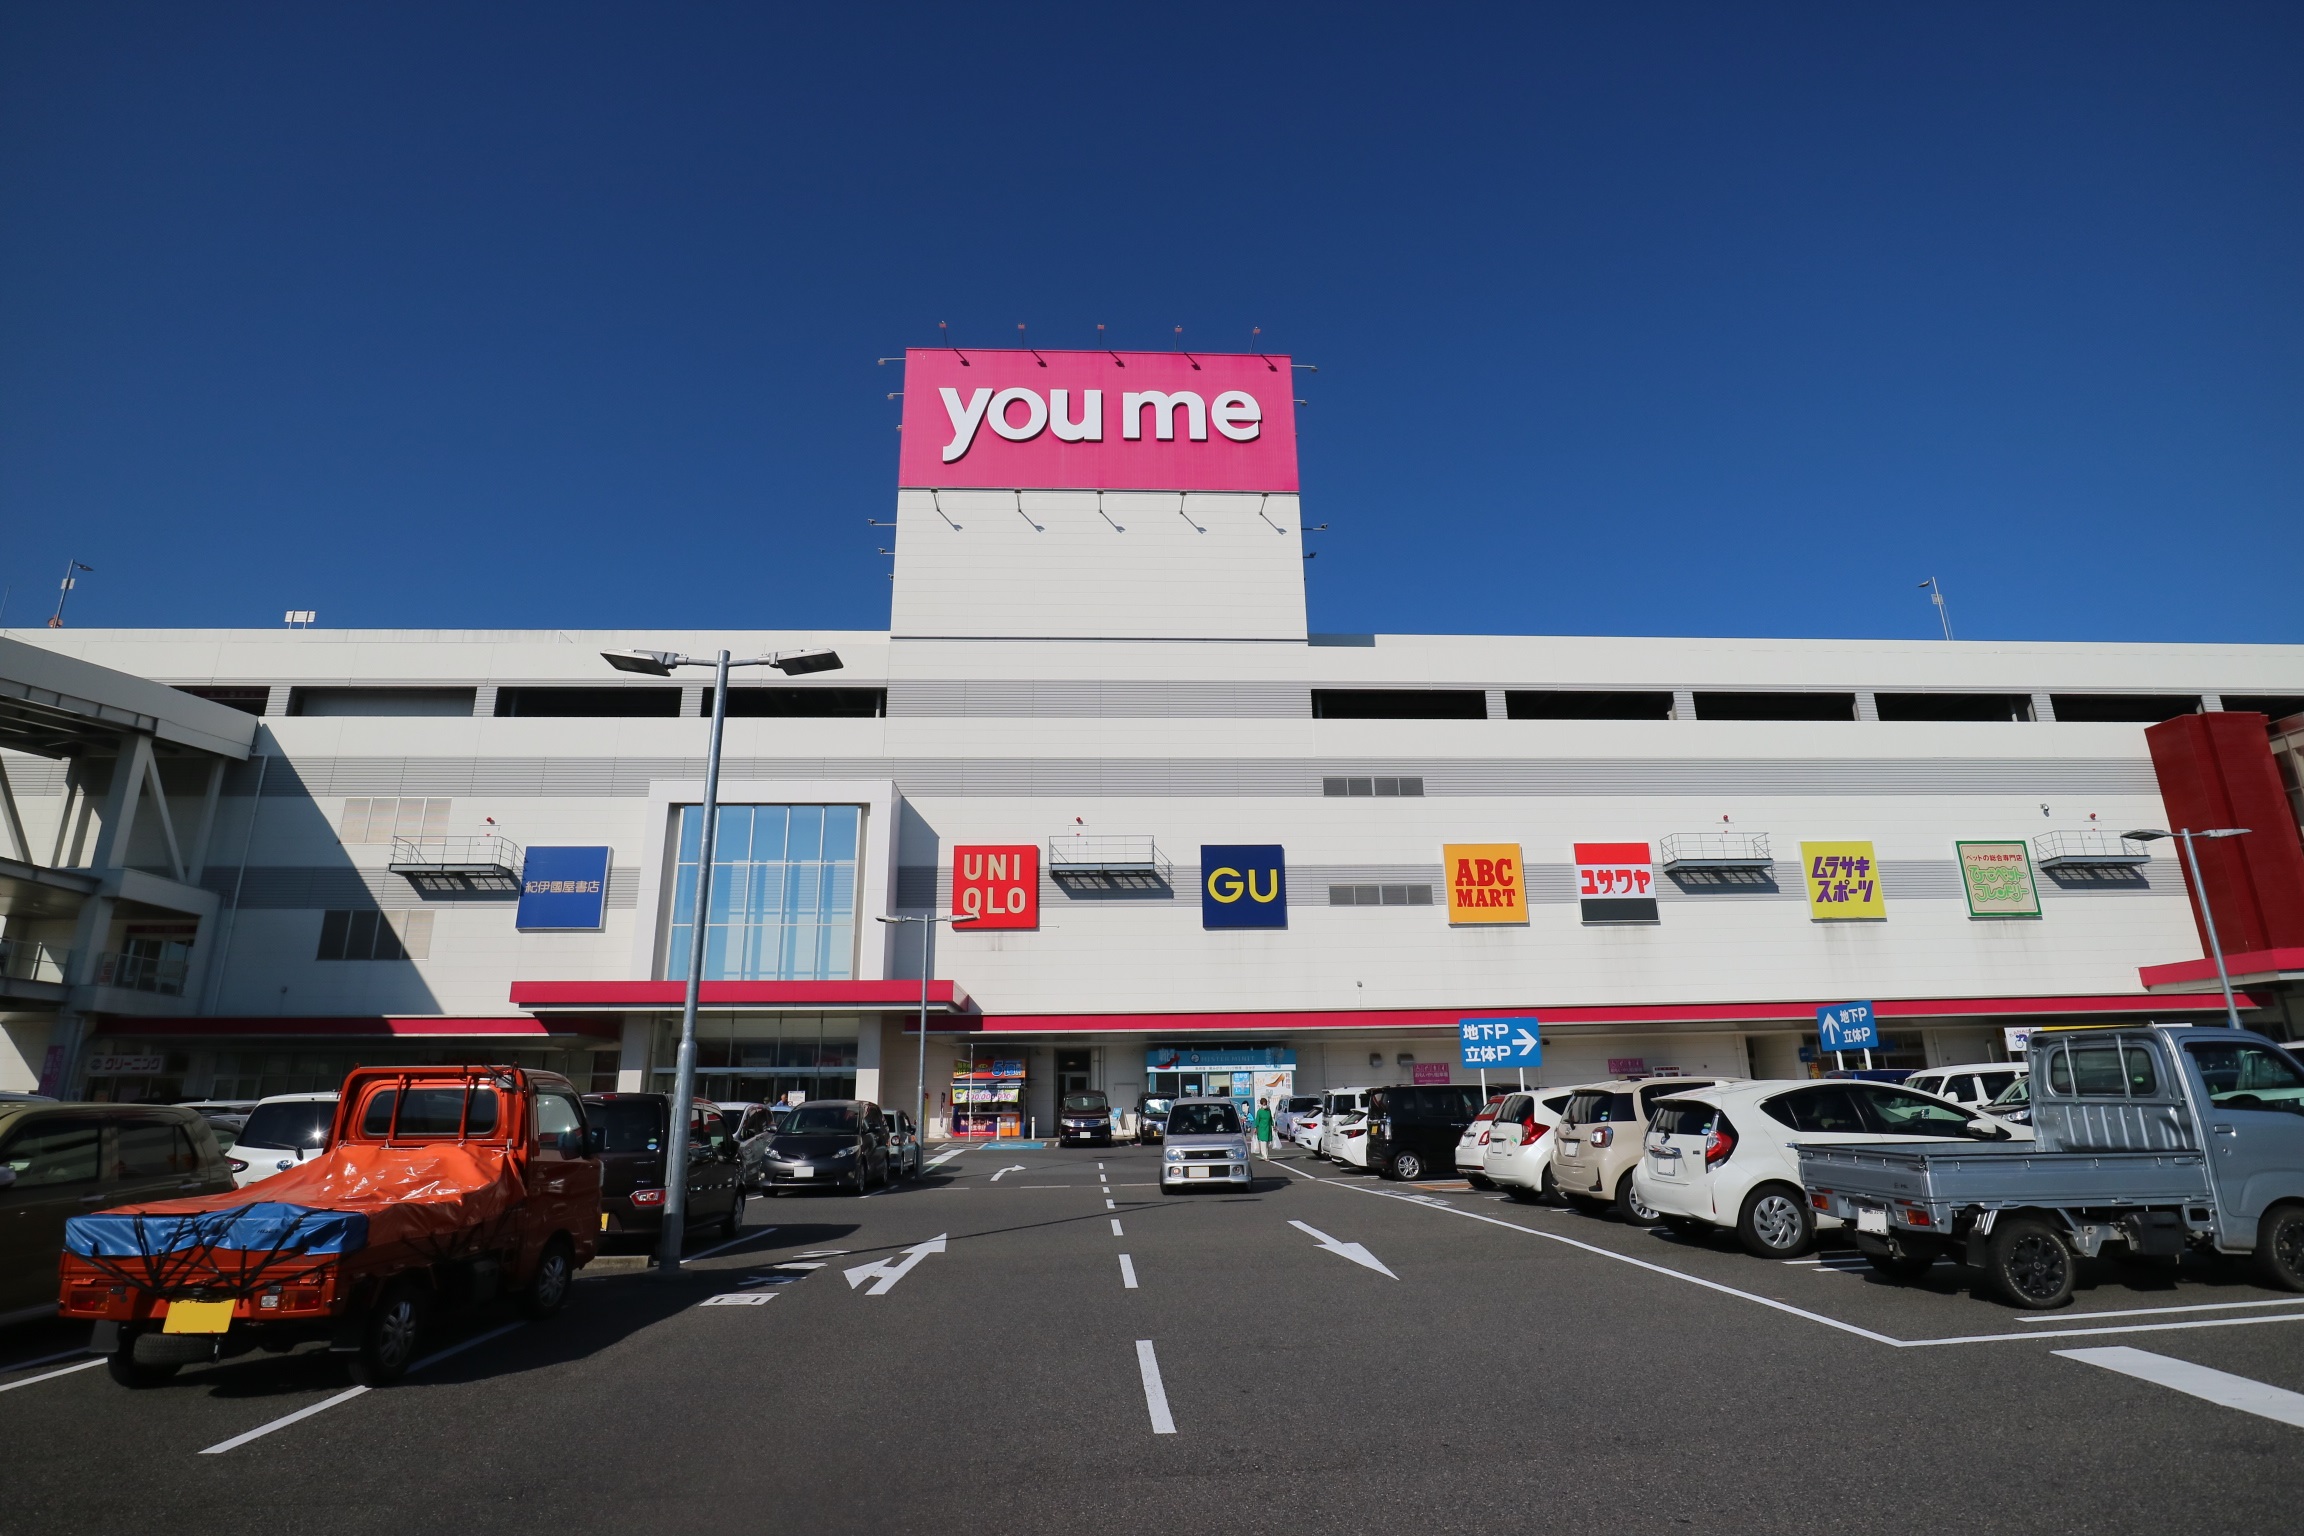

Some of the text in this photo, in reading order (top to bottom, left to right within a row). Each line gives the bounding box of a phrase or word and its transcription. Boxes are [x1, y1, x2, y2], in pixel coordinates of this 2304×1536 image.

[938, 387, 1262, 463] you me
[962, 854, 1021, 880] UNI
[1811, 856, 1870, 878] ムラサキ
[1966, 854, 2023, 862] ペットの総合専門店
[1455, 858, 1514, 887] ABC
[1581, 869, 1651, 894] ユザワヤ
[525, 880, 600, 893] 紀伊國屋書店
[1207, 867, 1278, 903] GU
[1816, 879, 1874, 902] スポーツ
[962, 887, 1026, 918] QLO
[1456, 889, 1516, 907] MART
[1840, 1007, 1867, 1024] 地下P
[1462, 1023, 1509, 1040] 地下P
[1843, 1027, 1871, 1043] 立体P
[1465, 1045, 1511, 1062] 立体P
